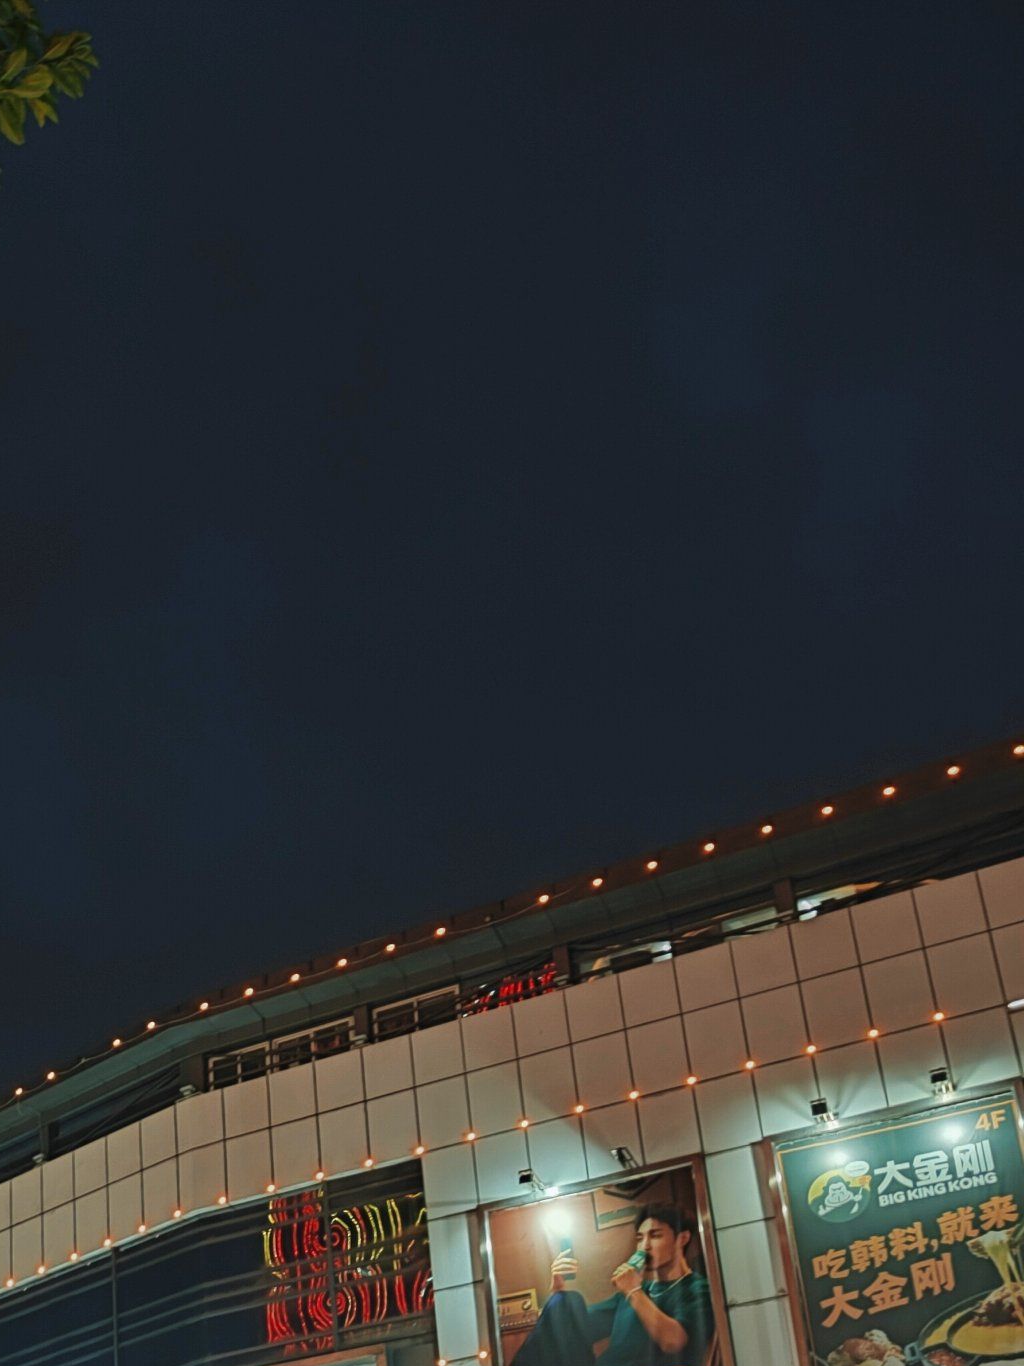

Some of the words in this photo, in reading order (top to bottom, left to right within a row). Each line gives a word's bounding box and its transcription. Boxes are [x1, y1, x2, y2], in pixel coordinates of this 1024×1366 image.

[976, 1109, 1006, 1131] 4F
[874, 1139, 994, 1194] 大金刚
[878, 1191, 906, 1207] BIG
[908, 1182, 946, 1201] KING
[948, 1171, 998, 1193] KONG
[819, 1252, 955, 1328] 大金刚
